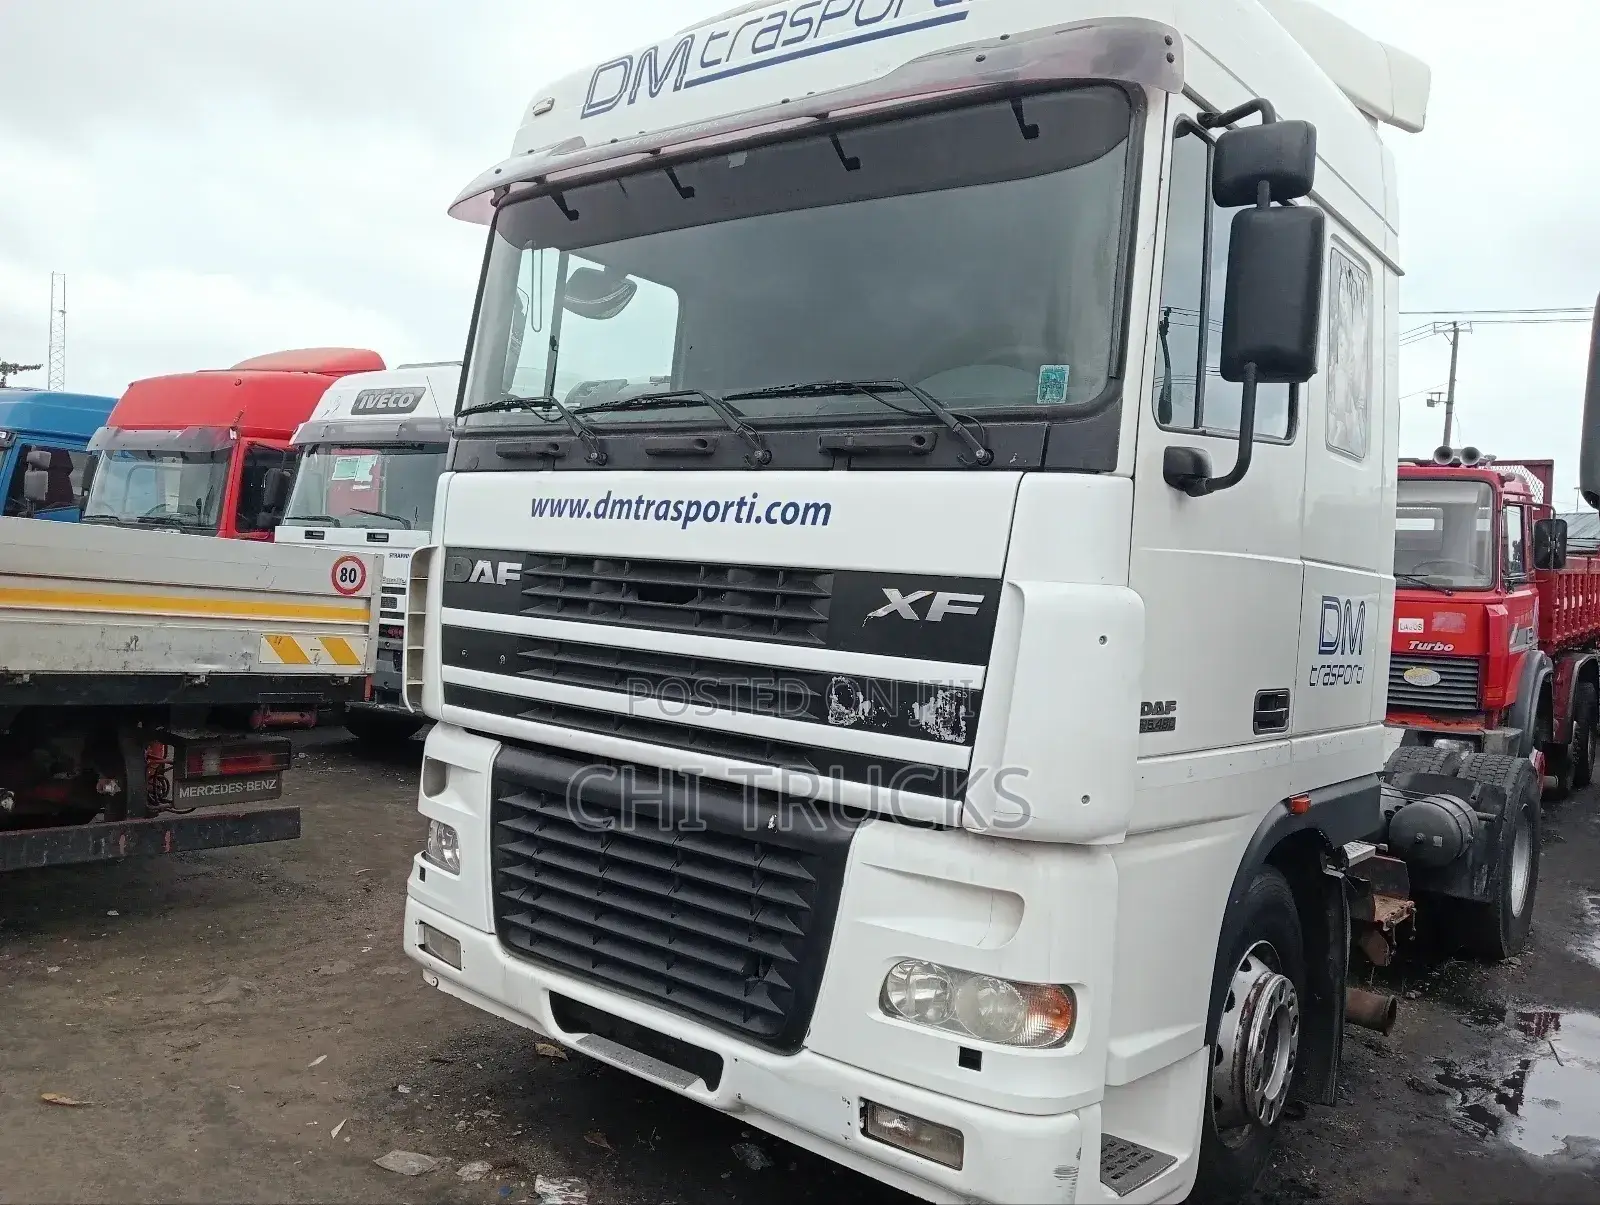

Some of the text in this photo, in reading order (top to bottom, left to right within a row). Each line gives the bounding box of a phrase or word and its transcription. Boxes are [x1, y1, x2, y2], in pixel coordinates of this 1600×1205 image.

[358, 392, 414, 410] IVECO
[531, 491, 832, 529] www.dmtrasporti.com
[340, 567, 357, 583] 80
[445, 556, 522, 585] DAF
[867, 588, 985, 621] XF
[1318, 595, 1366, 655] DM
[1408, 641, 1455, 652] Turbo
[1309, 664, 1366, 687] trasporti
[1140, 701, 1177, 716] DAF
[180, 779, 277, 798] MERCEDES-BENZ
